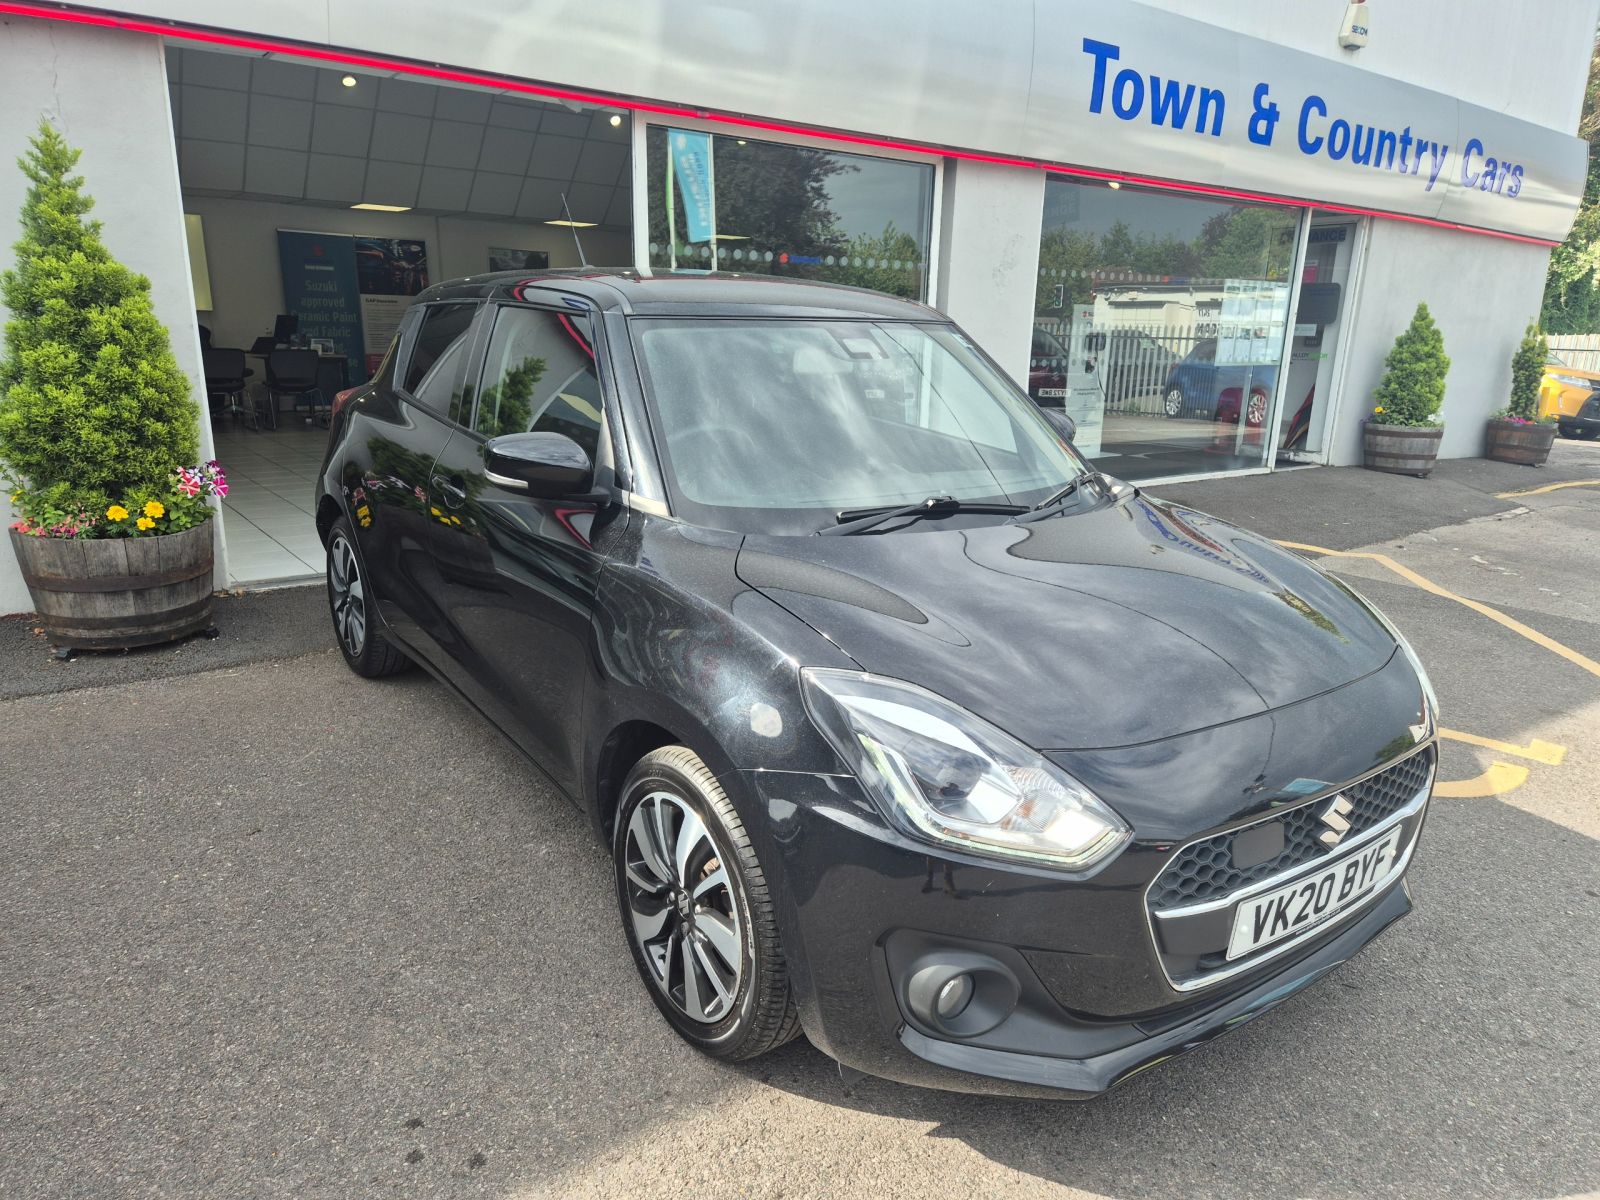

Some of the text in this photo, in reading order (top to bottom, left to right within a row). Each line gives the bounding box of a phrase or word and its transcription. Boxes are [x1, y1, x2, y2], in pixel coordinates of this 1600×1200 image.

[1082, 37, 1525, 198] Town & Country Cars
[305, 280, 337, 292] Suzuki
[1252, 873, 1336, 944] VK20
[1337, 838, 1391, 903] BYF
